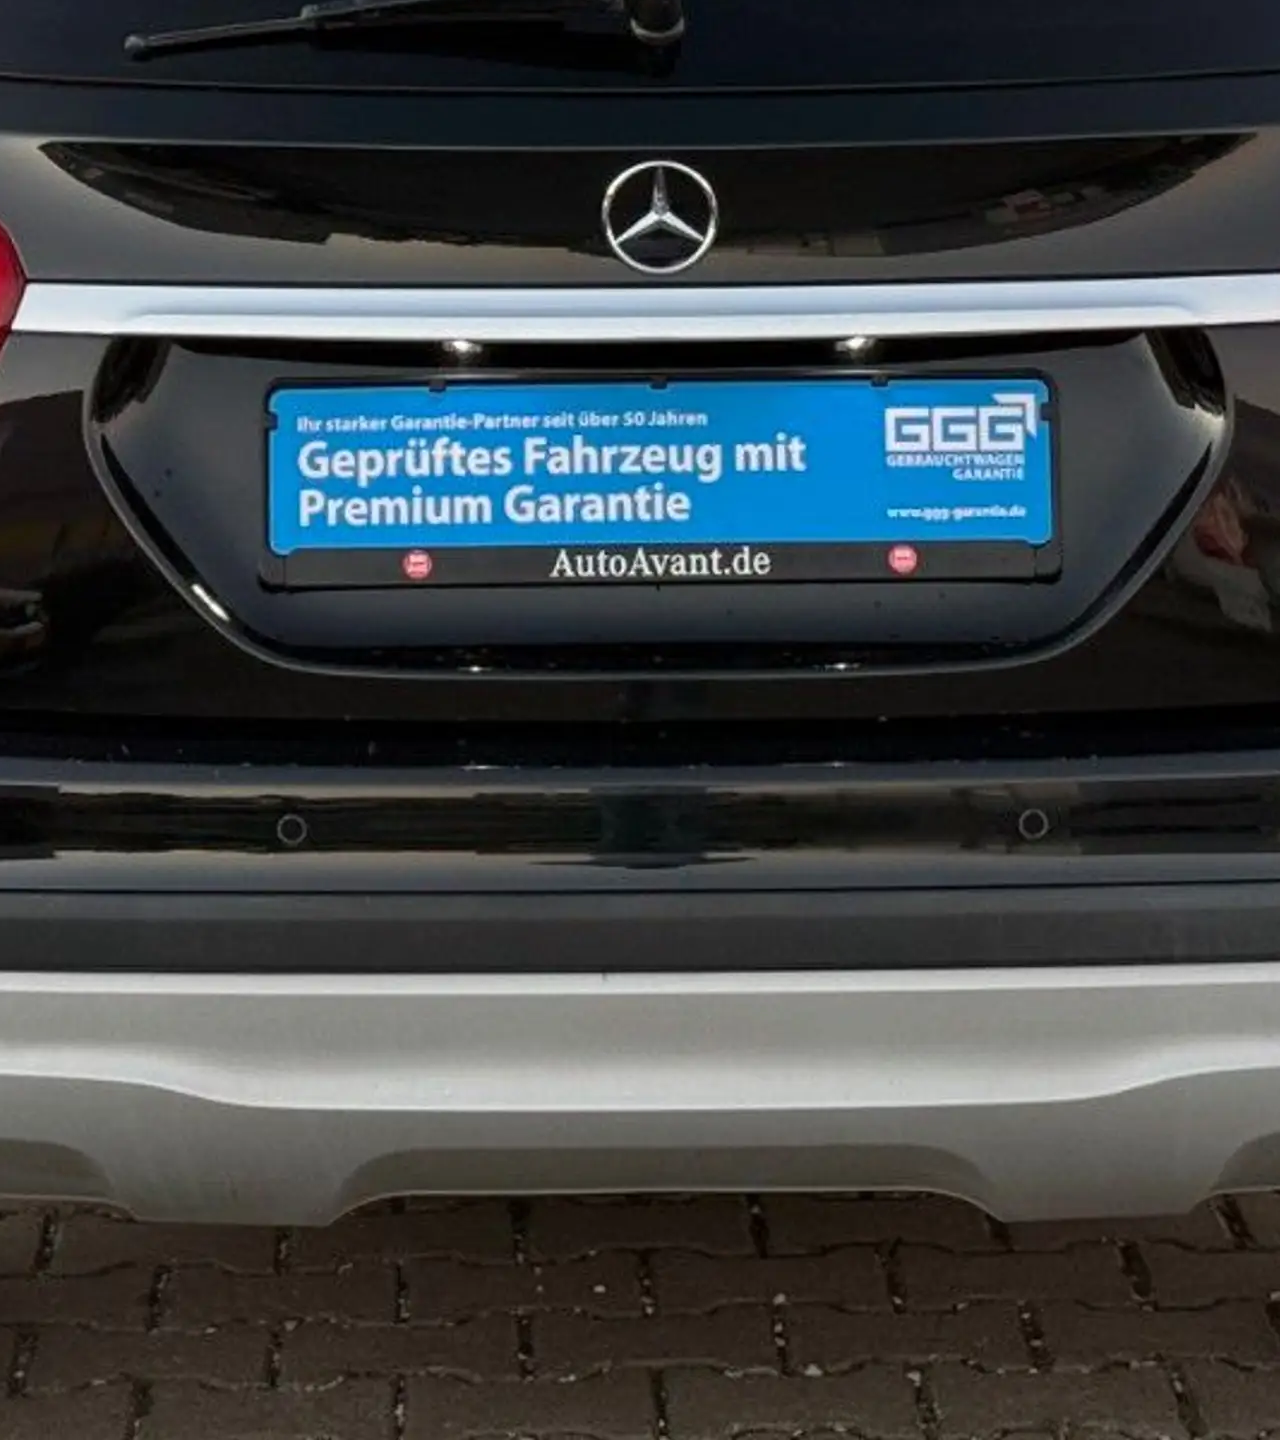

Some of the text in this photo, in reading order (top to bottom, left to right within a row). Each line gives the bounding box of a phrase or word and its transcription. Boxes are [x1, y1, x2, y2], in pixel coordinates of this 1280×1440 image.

[297, 411, 708, 432] Ihr starker Garantie-Partner seit über 50 Jahren
[885, 406, 1025, 452] GGG
[297, 431, 808, 487] Geprüftes Fahrzeug mit
[299, 482, 692, 526] Premium Garantie
[549, 545, 772, 579] AutoAvant.de
